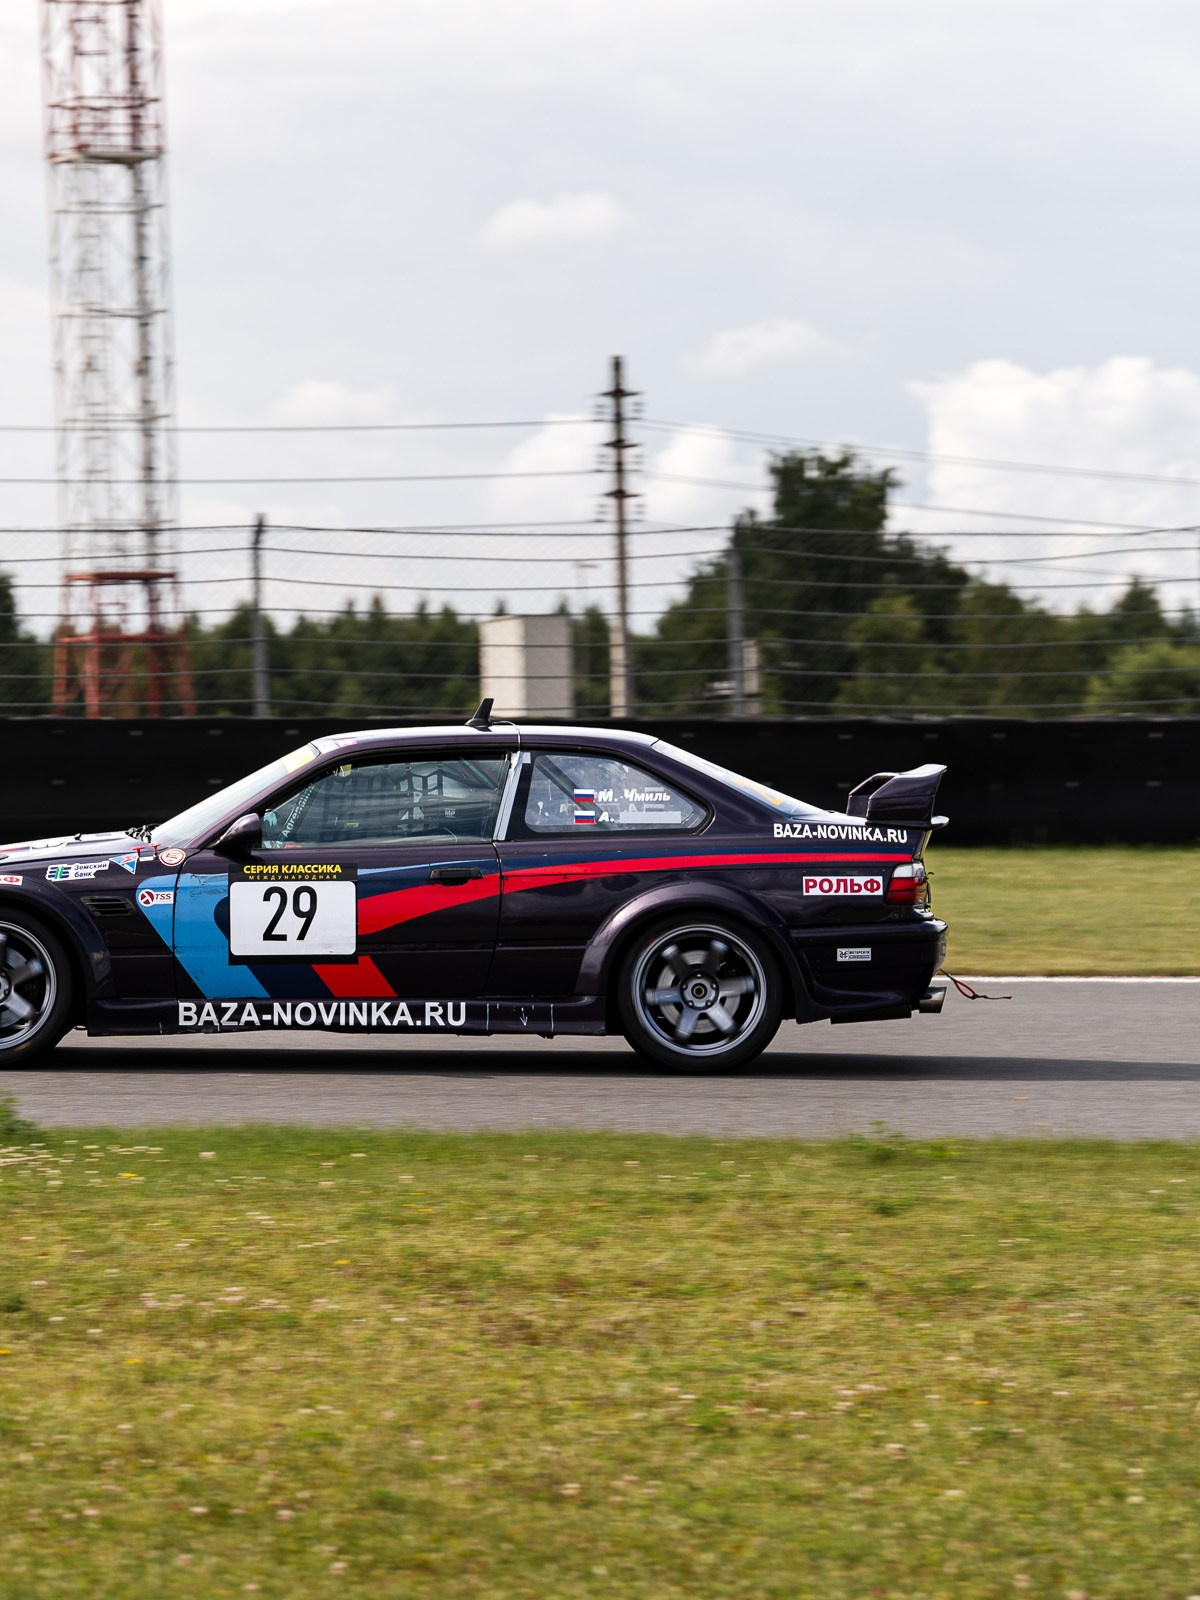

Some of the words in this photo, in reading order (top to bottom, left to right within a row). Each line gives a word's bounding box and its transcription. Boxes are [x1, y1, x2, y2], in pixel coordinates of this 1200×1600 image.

[623, 789, 671, 802] Чмиль
[773, 822, 908, 844] BAZA-NOVINKA.RU
[74, 863, 108, 871] Земский
[243, 864, 279, 874] СЕРИЯ
[281, 864, 342, 874] КЛАССИКА
[804, 878, 881, 894] РОЛЬФ
[262, 885, 318, 942] 29
[177, 1001, 467, 1027] BAZA-NOVINKA.RU
